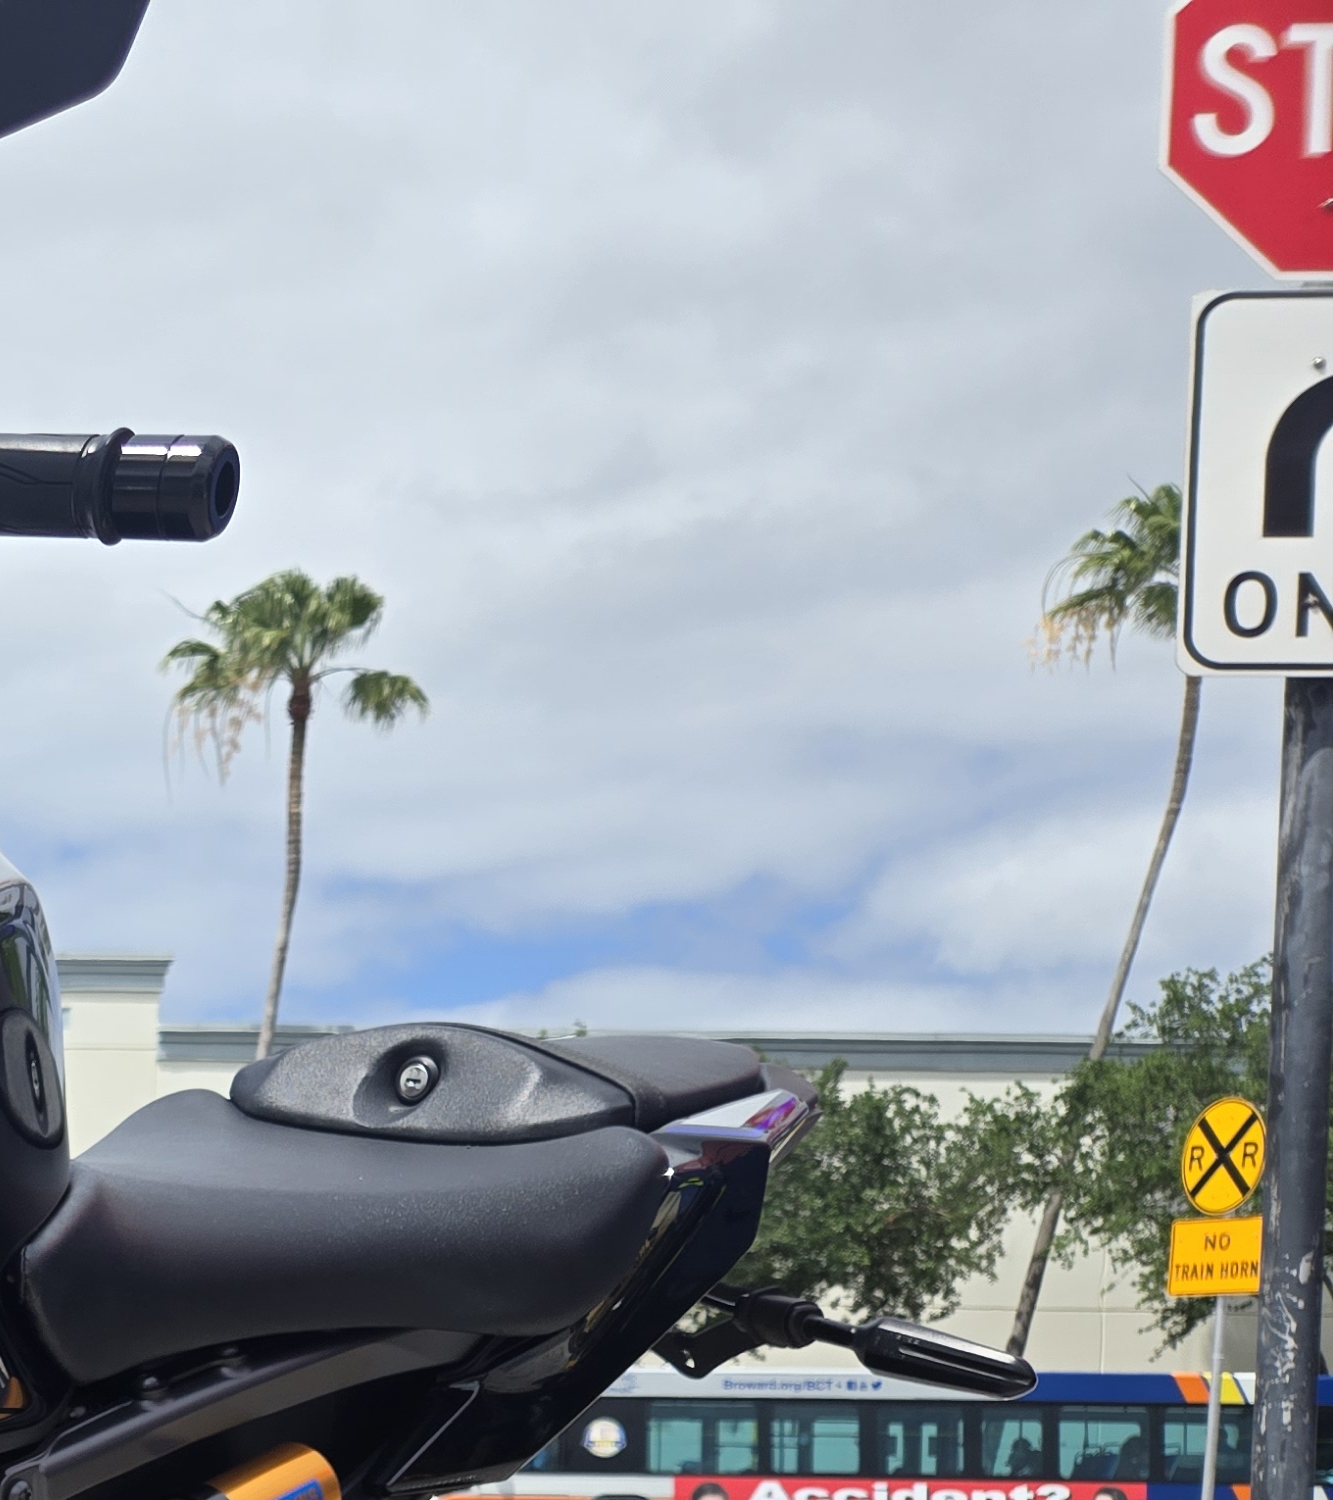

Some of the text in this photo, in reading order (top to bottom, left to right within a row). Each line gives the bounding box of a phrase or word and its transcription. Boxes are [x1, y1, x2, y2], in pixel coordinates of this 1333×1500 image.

[1191, 23, 1333, 158] ST
[1223, 570, 1333, 638] ON
[1204, 1232, 1231, 1252] NO
[1174, 1260, 1259, 1281] TRAIN HORN
